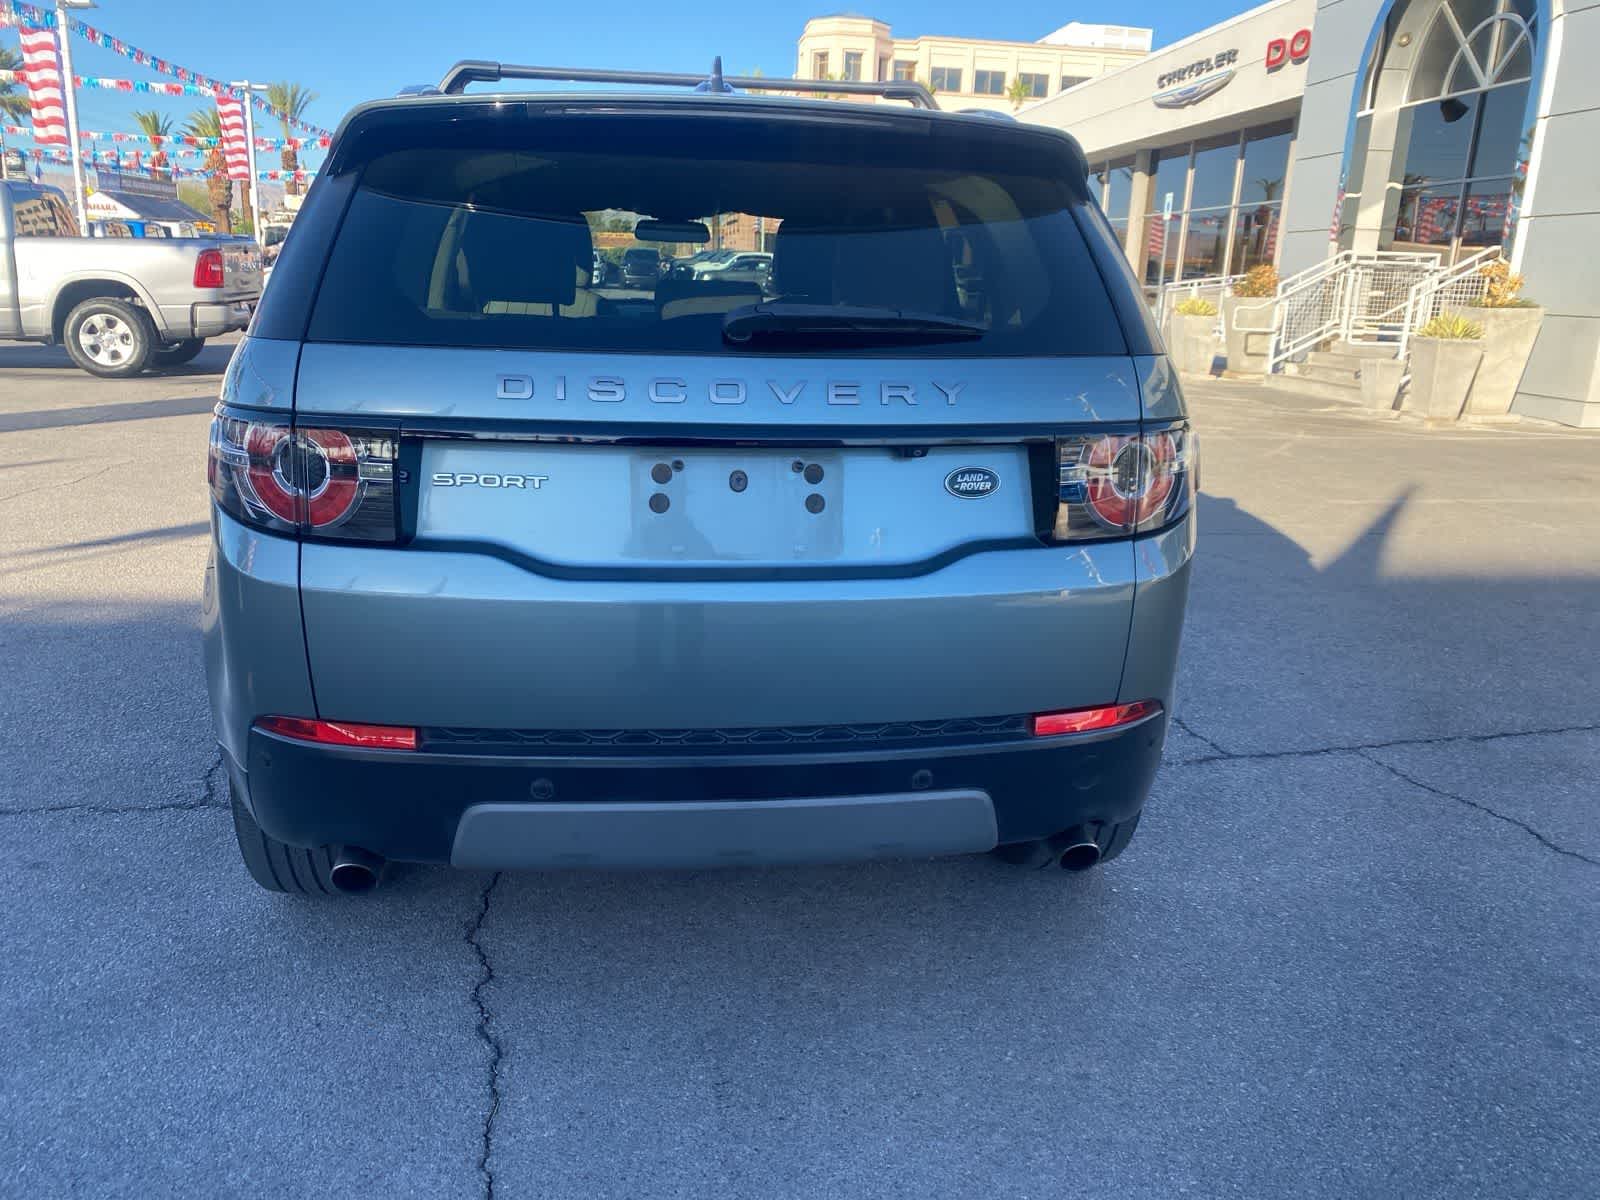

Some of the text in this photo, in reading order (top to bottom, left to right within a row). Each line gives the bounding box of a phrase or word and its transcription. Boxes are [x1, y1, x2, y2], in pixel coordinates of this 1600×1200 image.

[1157, 48, 1240, 89] CHRYSLER
[496, 374, 967, 406] DISCOVERY
[432, 473, 549, 489] SPORT
[957, 473, 984, 482] LAND
[960, 482, 991, 490] ROVER
